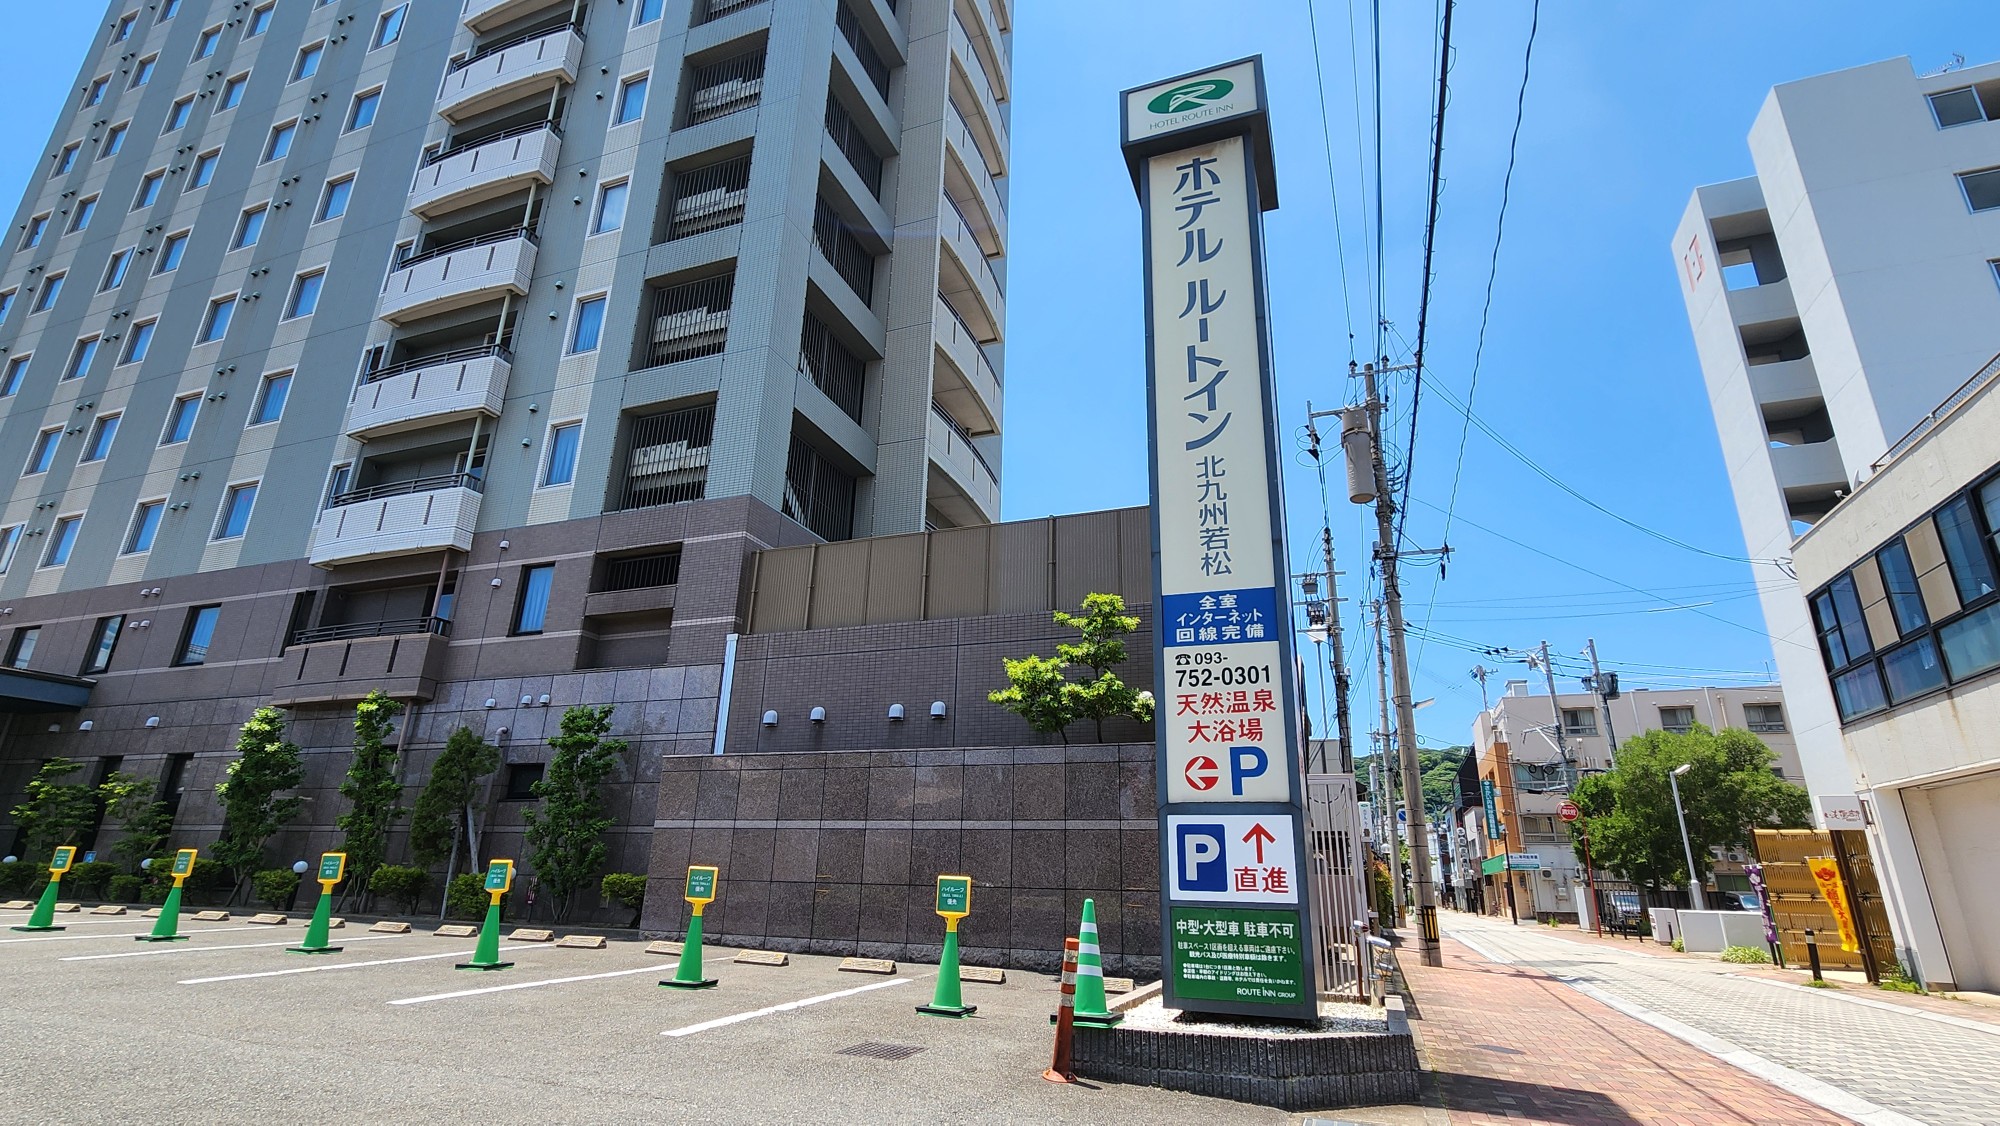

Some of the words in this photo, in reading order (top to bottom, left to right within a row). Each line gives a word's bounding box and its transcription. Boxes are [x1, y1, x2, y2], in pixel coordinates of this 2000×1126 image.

[1149, 117, 1180, 130] HOTEL
[1181, 108, 1214, 122] ROUTE
[1215, 103, 1234, 114] INN
[1172, 156, 1224, 268] ホテル
[1195, 455, 1233, 577] 北九州若松
[1198, 593, 1238, 610] 全室
[1176, 608, 1263, 626] インターネット
[1176, 623, 1265, 643] 回線完備
[1175, 664, 1270, 688] 752-0301
[1176, 688, 1277, 716] 天然温泉
[1187, 717, 1263, 743] 大浴場
[1229, 746, 1269, 796] P
[1184, 834, 1220, 881] P
[1233, 866, 1289, 893] 直進
[1243, 921, 1294, 939] 駐車不可
[1236, 987, 1261, 996] ROUTE
[1262, 986, 1276, 997] INN
